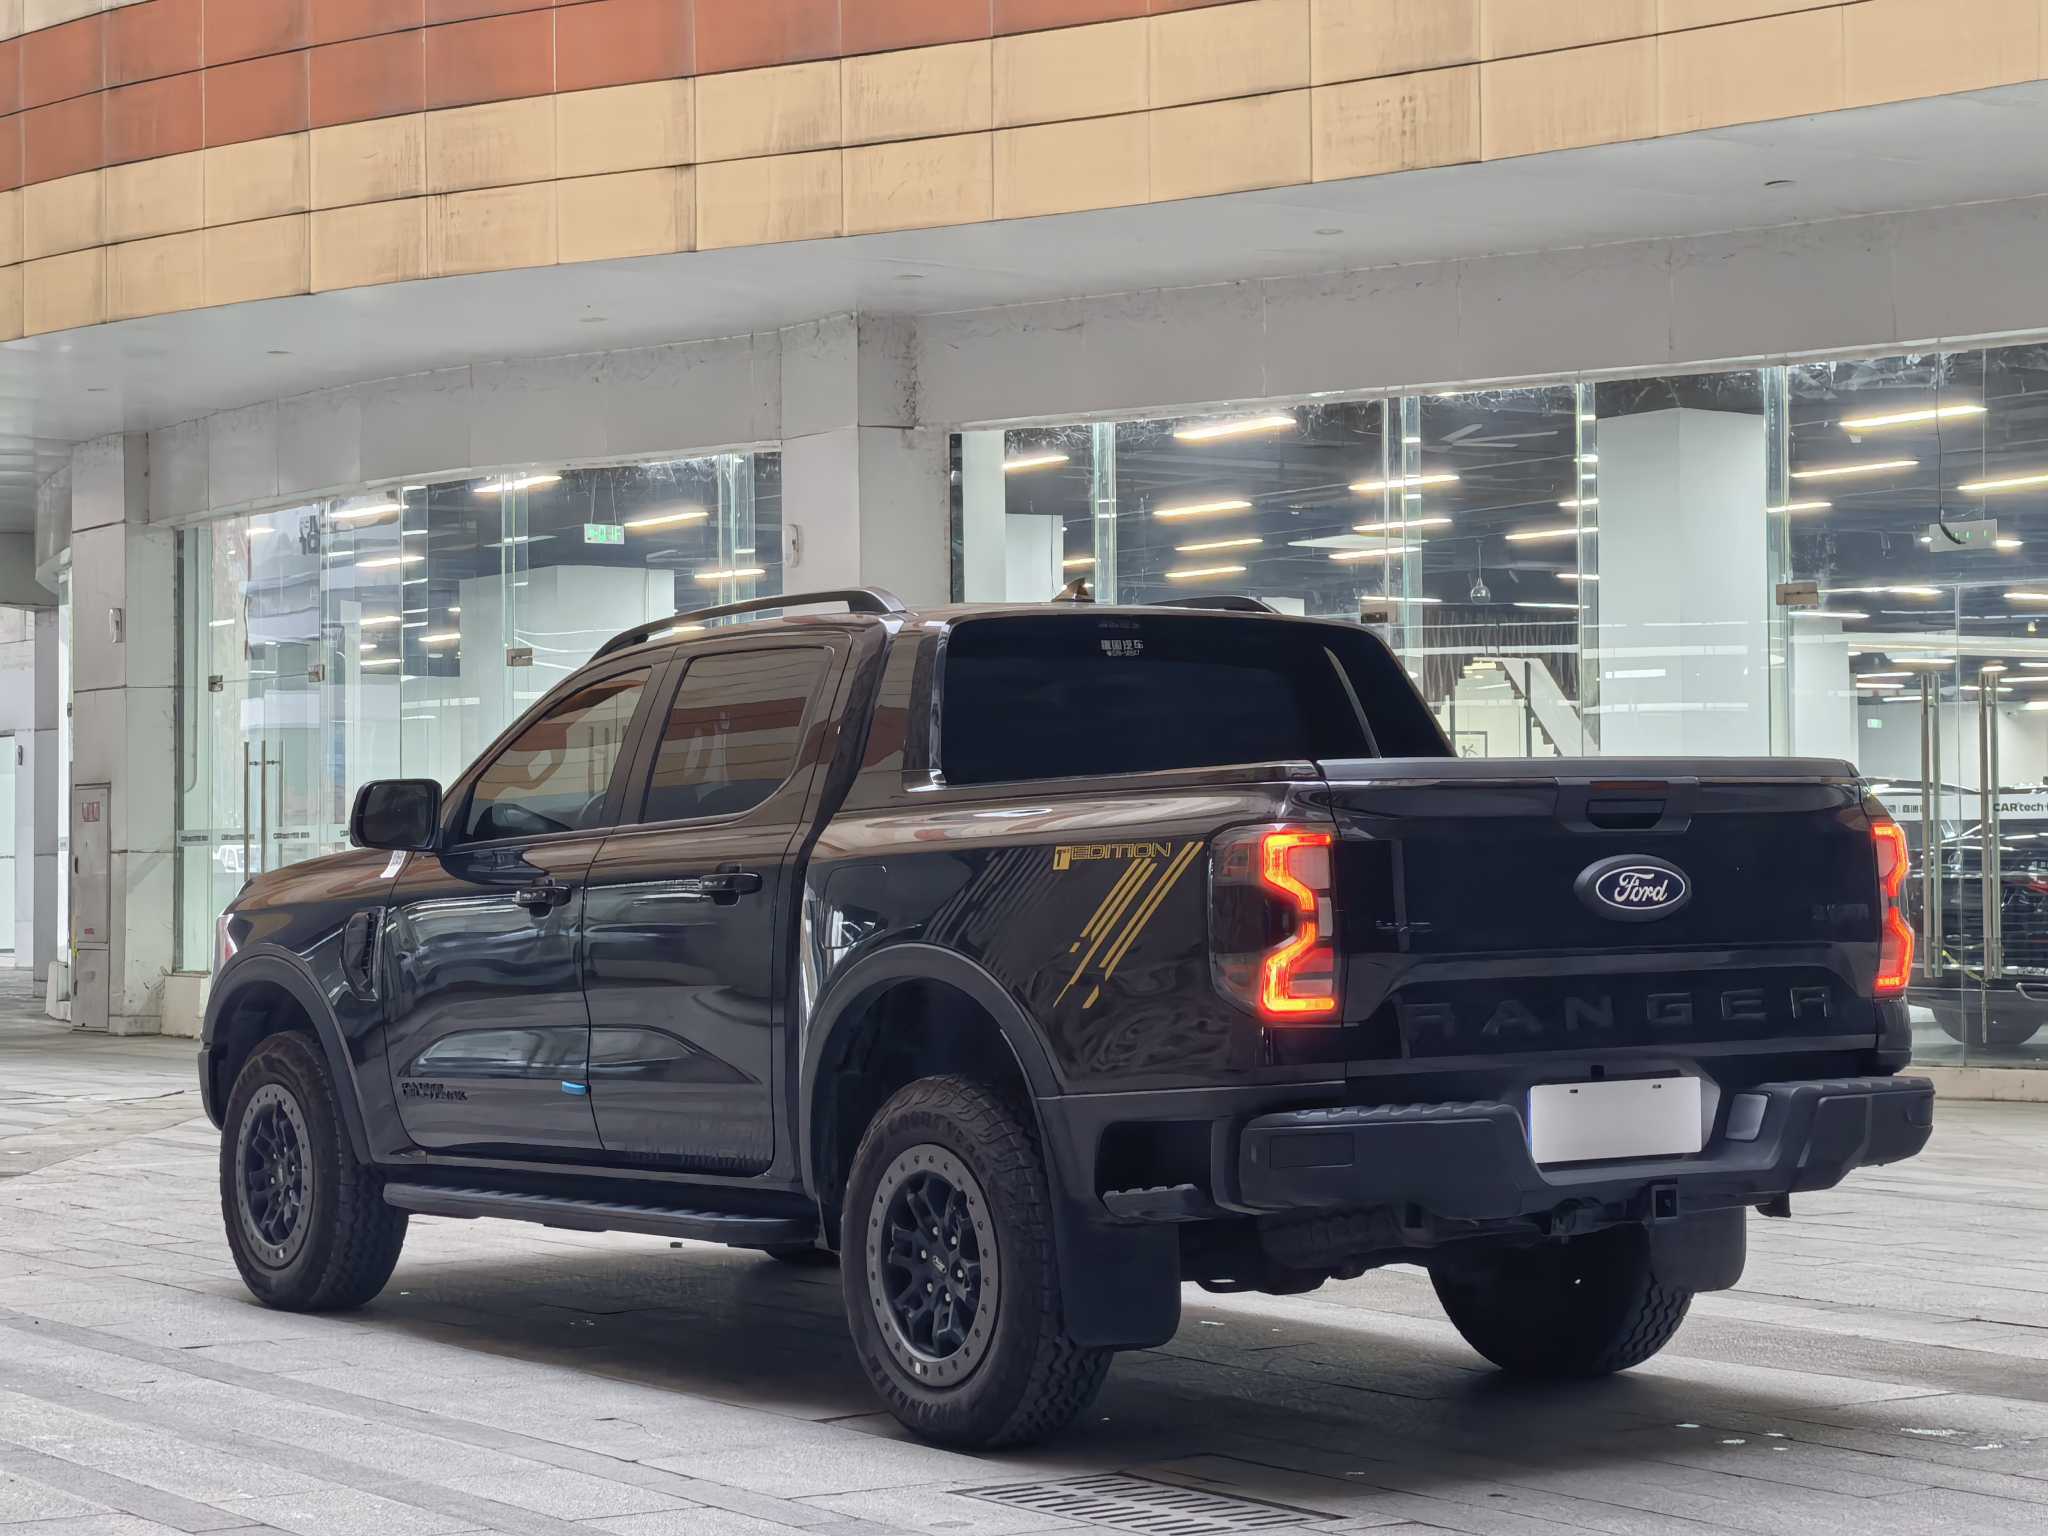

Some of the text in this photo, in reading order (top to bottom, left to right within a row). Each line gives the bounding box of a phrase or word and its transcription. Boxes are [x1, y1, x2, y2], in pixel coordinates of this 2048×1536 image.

[1072, 841, 1171, 860] EDITION
[1614, 871, 1669, 902] Ford
[1401, 986, 1832, 1037] RANGER
